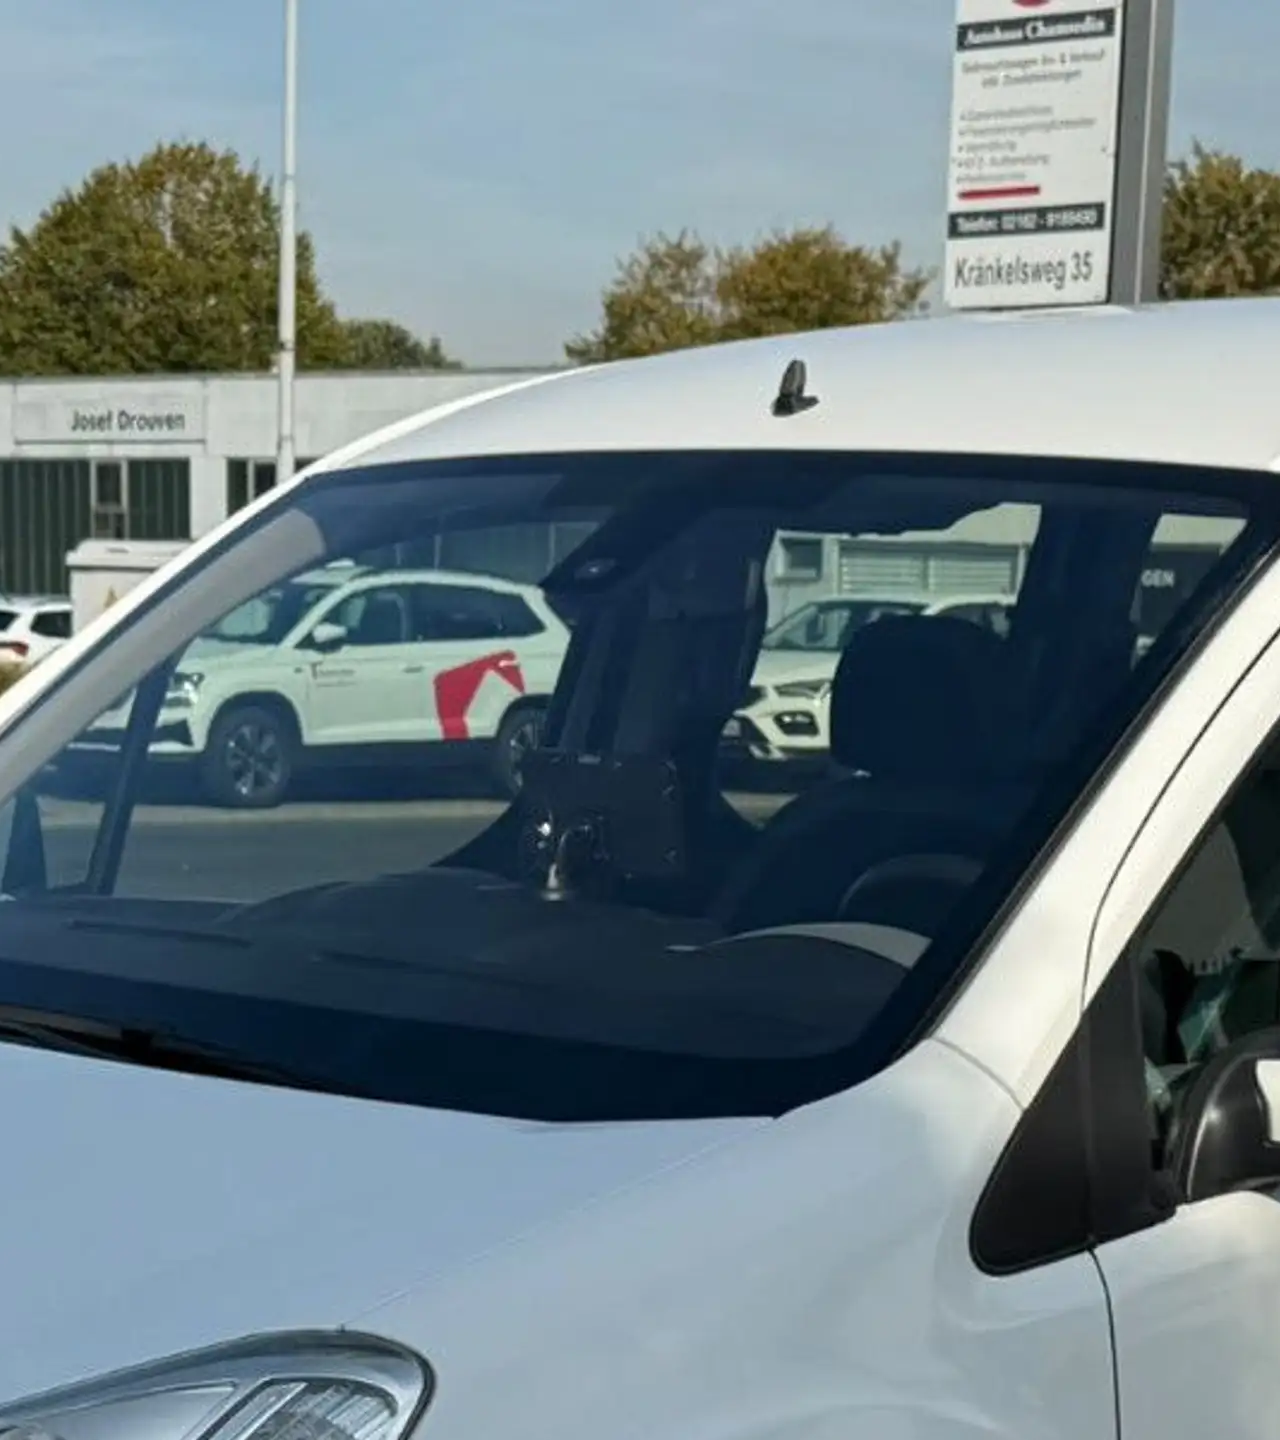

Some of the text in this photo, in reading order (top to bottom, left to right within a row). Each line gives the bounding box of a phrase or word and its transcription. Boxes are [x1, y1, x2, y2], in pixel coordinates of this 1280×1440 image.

[954, 250, 1093, 291] Kränkelsweg 35
[71, 409, 185, 432] Josef Drouven
